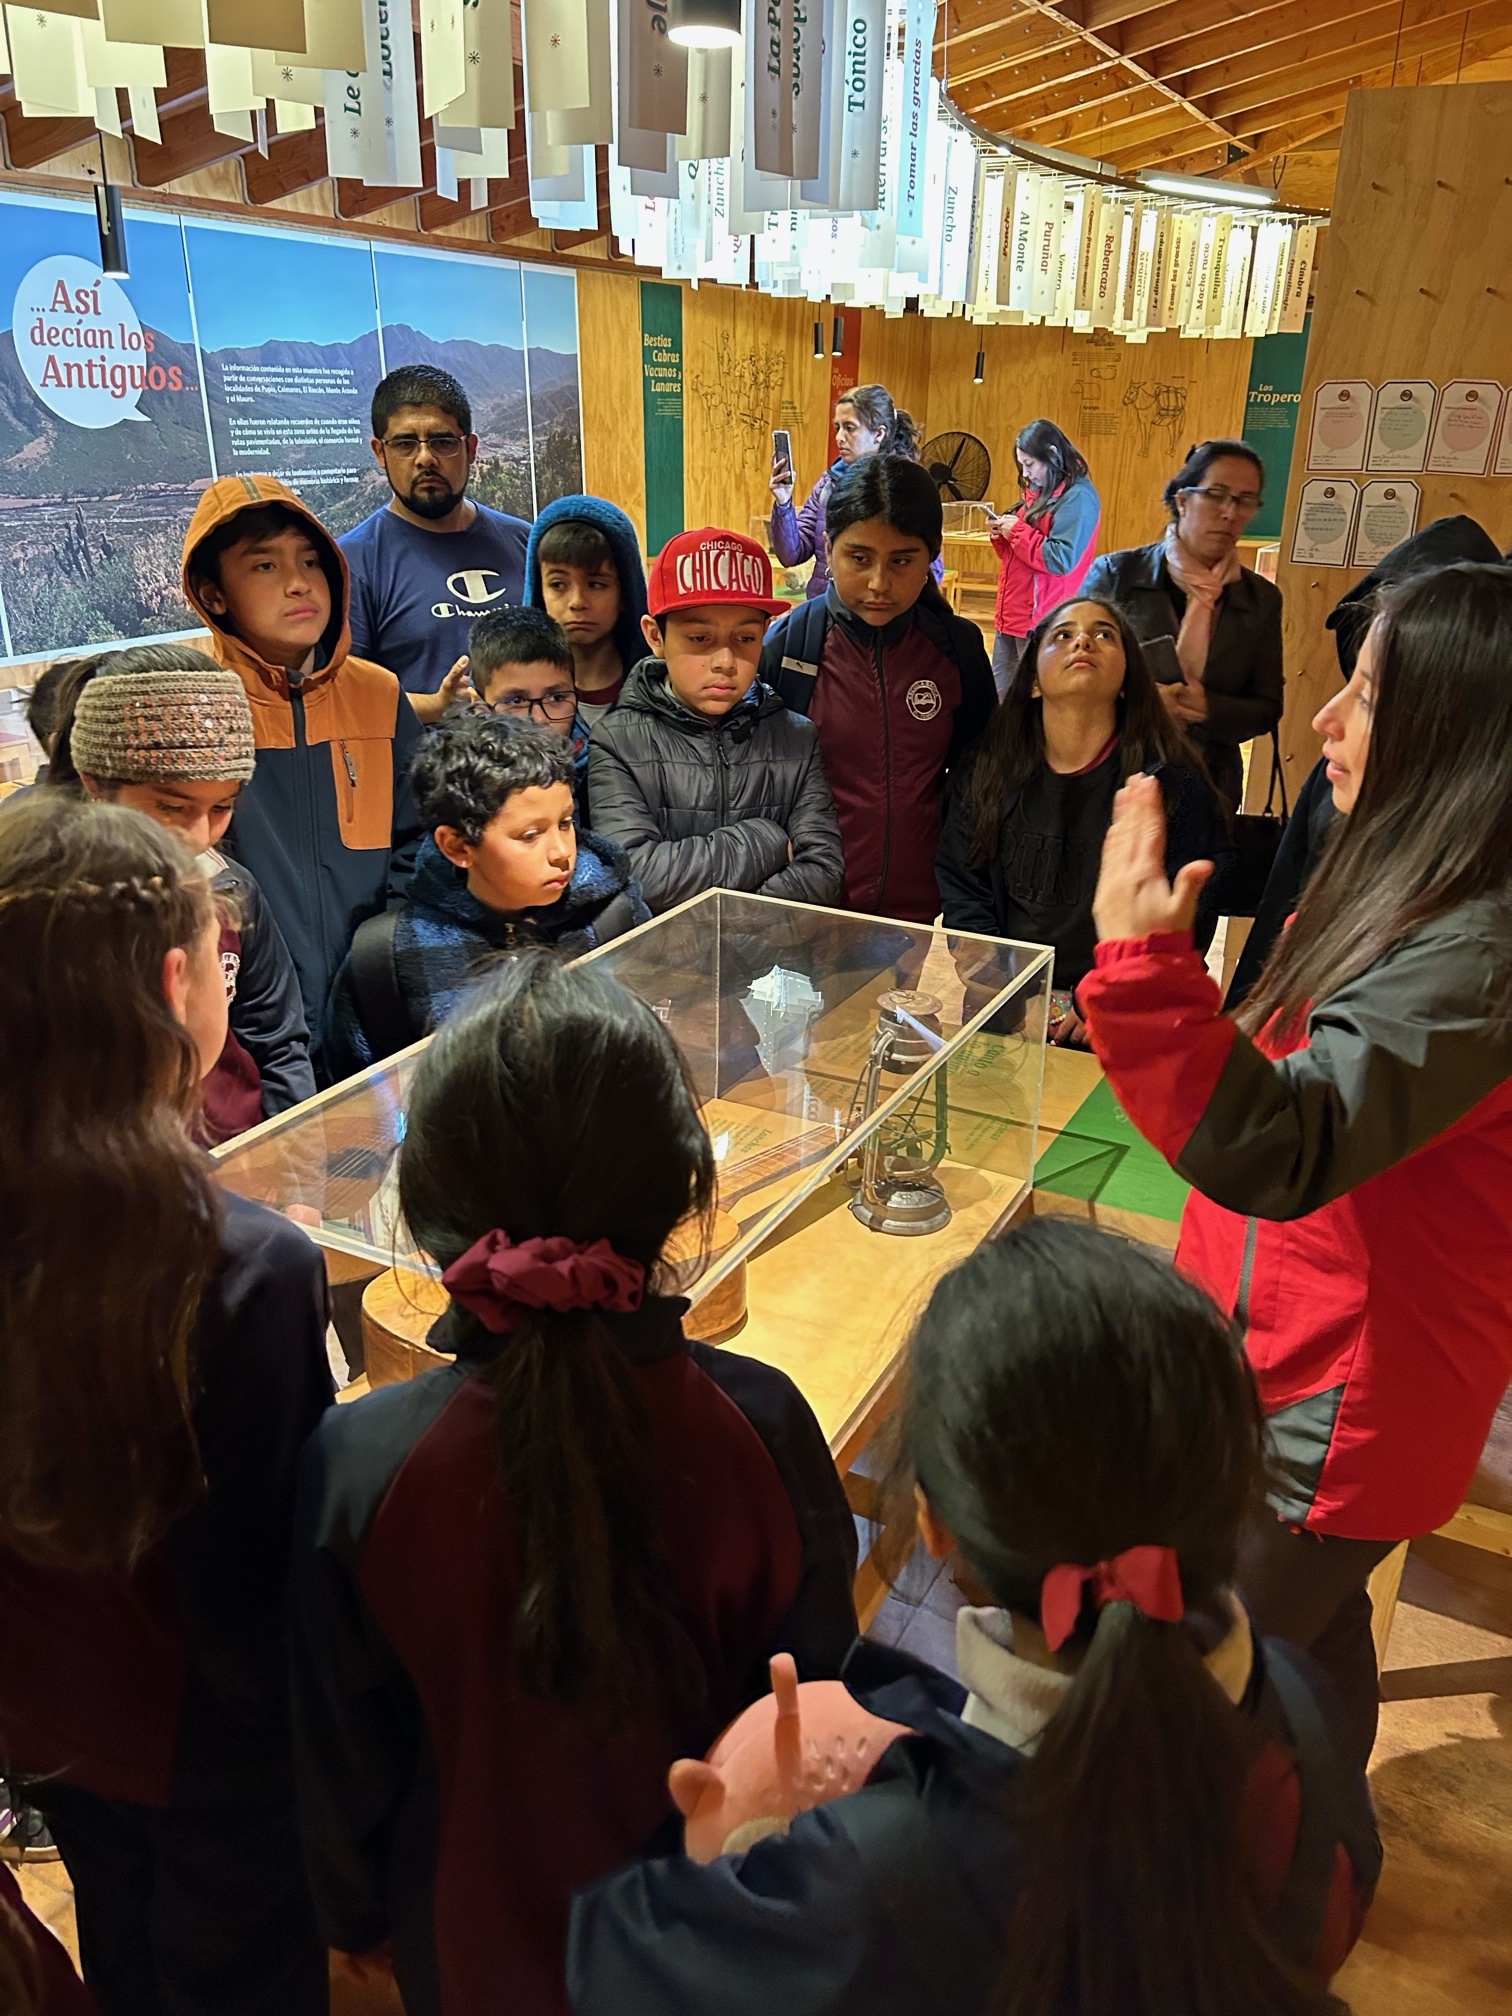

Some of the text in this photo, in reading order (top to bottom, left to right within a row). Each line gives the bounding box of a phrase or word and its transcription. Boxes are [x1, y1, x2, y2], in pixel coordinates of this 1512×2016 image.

[767, 38, 781, 79] La
[844, 17, 868, 113] Tónico
[344, 86, 361, 117] Le
[907, 38, 922, 203] Tomar las gracias
[714, 157, 725, 218] Zuncho
[945, 186, 958, 243] Zuncho
[1016, 211, 1030, 273] Al Monte
[1040, 221, 1055, 275] Puruñar
[1098, 234, 1115, 298] Rebencazo
[1186, 240, 1197, 288] Echonas
[1196, 243, 1210, 311] Macho rucio
[1212, 236, 1226, 300] Tranquillas
[1296, 260, 1308, 298] Cimbra
[1168, 282, 1178, 312] Tomar
[30, 317, 156, 352] decían los
[643, 333, 672, 348] Bestias
[229, 363, 260, 372] información
[260, 365, 285, 373] contenida
[643, 364, 677, 378] Vacunos
[652, 349, 680, 364] Cabras
[223, 374, 239, 383] partir
[246, 375, 285, 383] conversaciones
[224, 384, 254, 392] localidades
[650, 380, 682, 393] Lanares
[1259, 383, 1274, 392] Los
[1249, 391, 1302, 406] Tropero
[700, 540, 743, 552] CHICAGO
[676, 550, 764, 597] CHICAGO
[431, 602, 519, 618] Cham
[974, 1044, 1007, 1070] Canto
[740, 1128, 773, 1154] Lanchas
